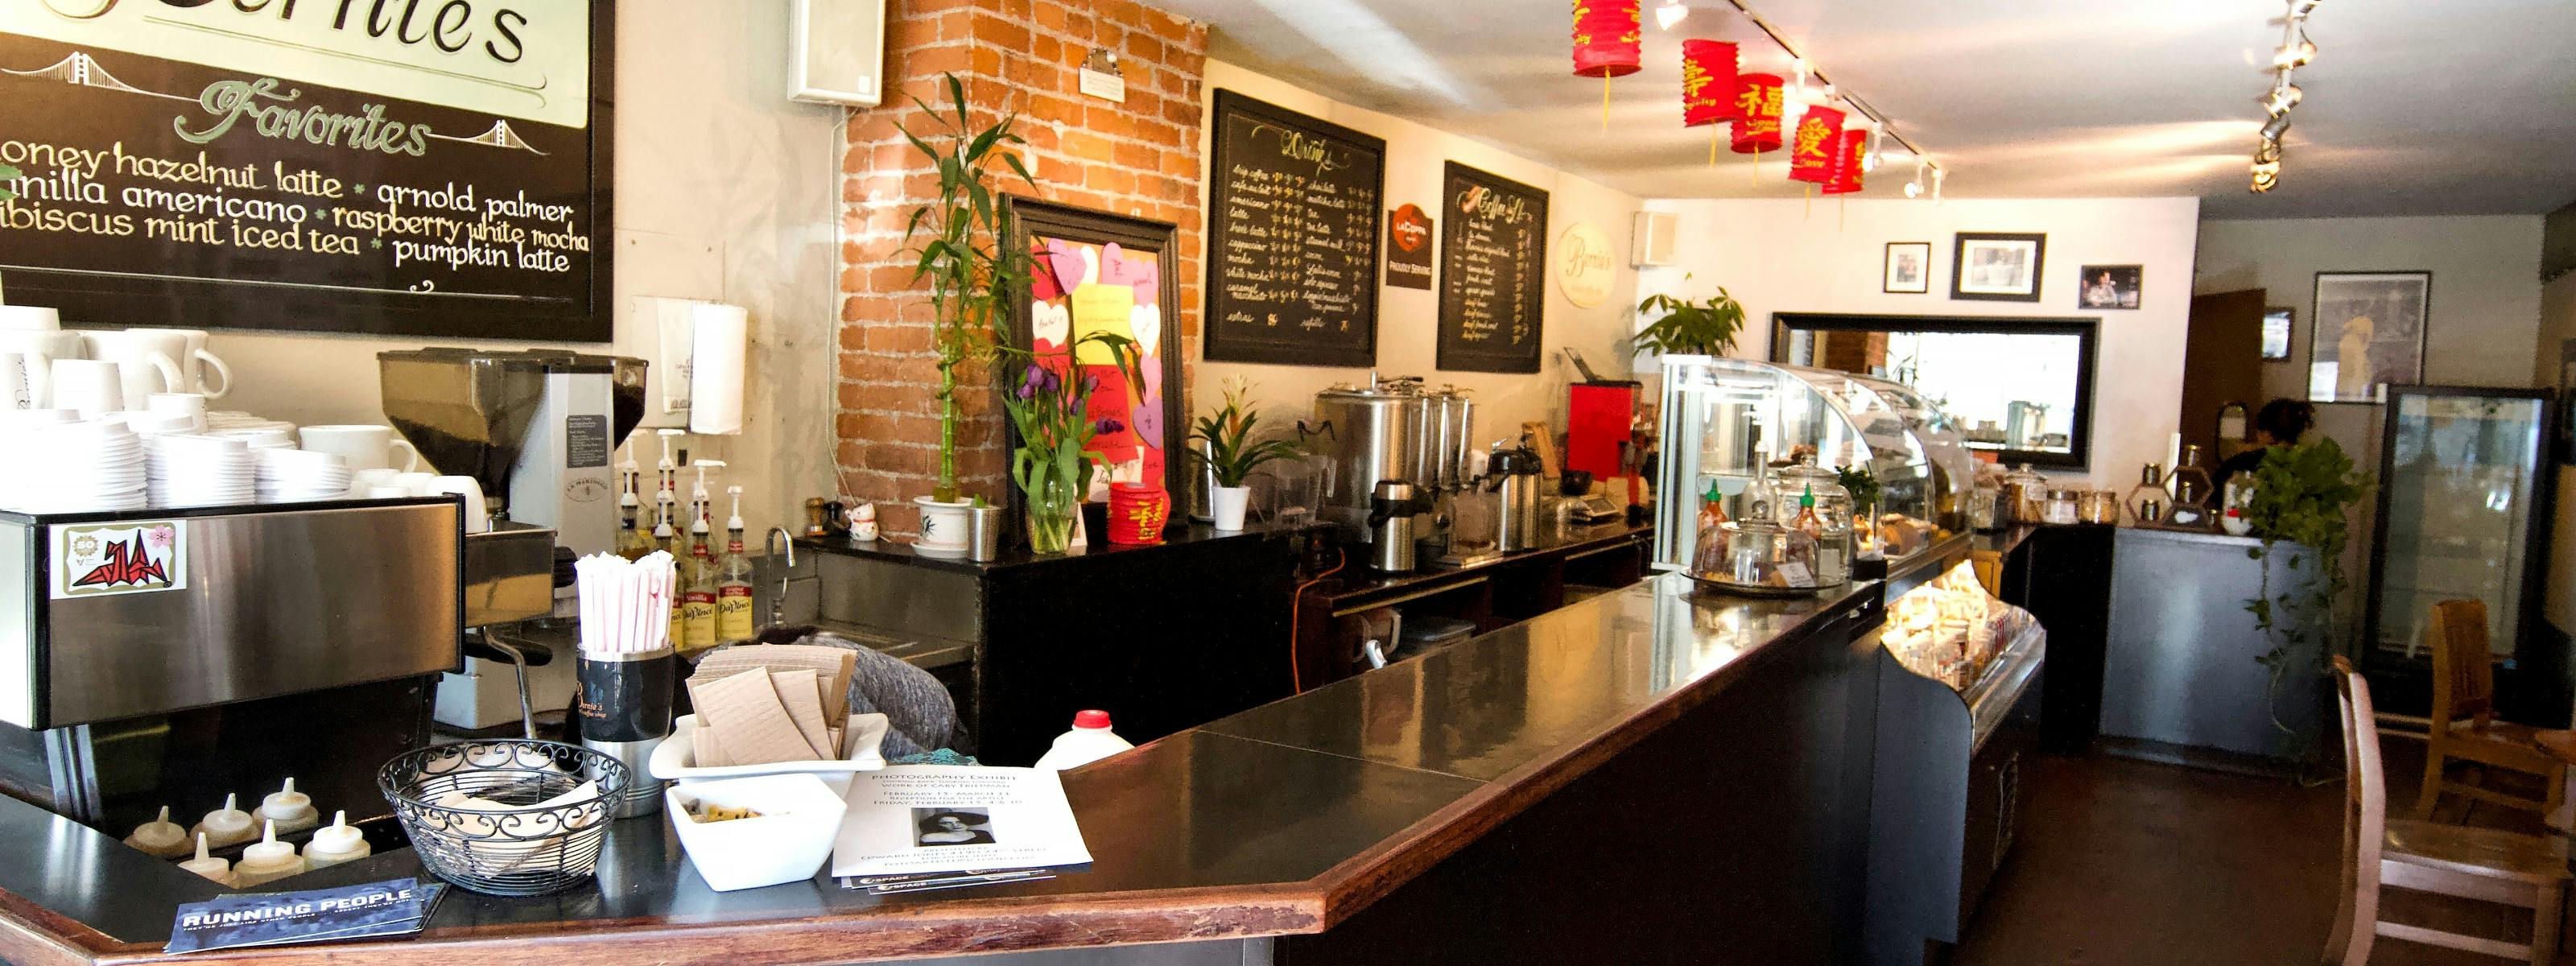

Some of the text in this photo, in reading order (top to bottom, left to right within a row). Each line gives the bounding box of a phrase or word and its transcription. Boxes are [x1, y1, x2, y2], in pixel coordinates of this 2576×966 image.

[175, 77, 431, 156] Favorites
[1735, 84, 1783, 117] 福
[1795, 117, 1832, 156] 愛
[0, 141, 574, 222] oney hazelnut latte arnold palmer
[10, 167, 588, 252] nilla americano raspberry white mocha
[0, 199, 570, 272] ibiscus mint iced tea pumpkin latte
[182, 889, 412, 927] RUNNING PEOPLE
